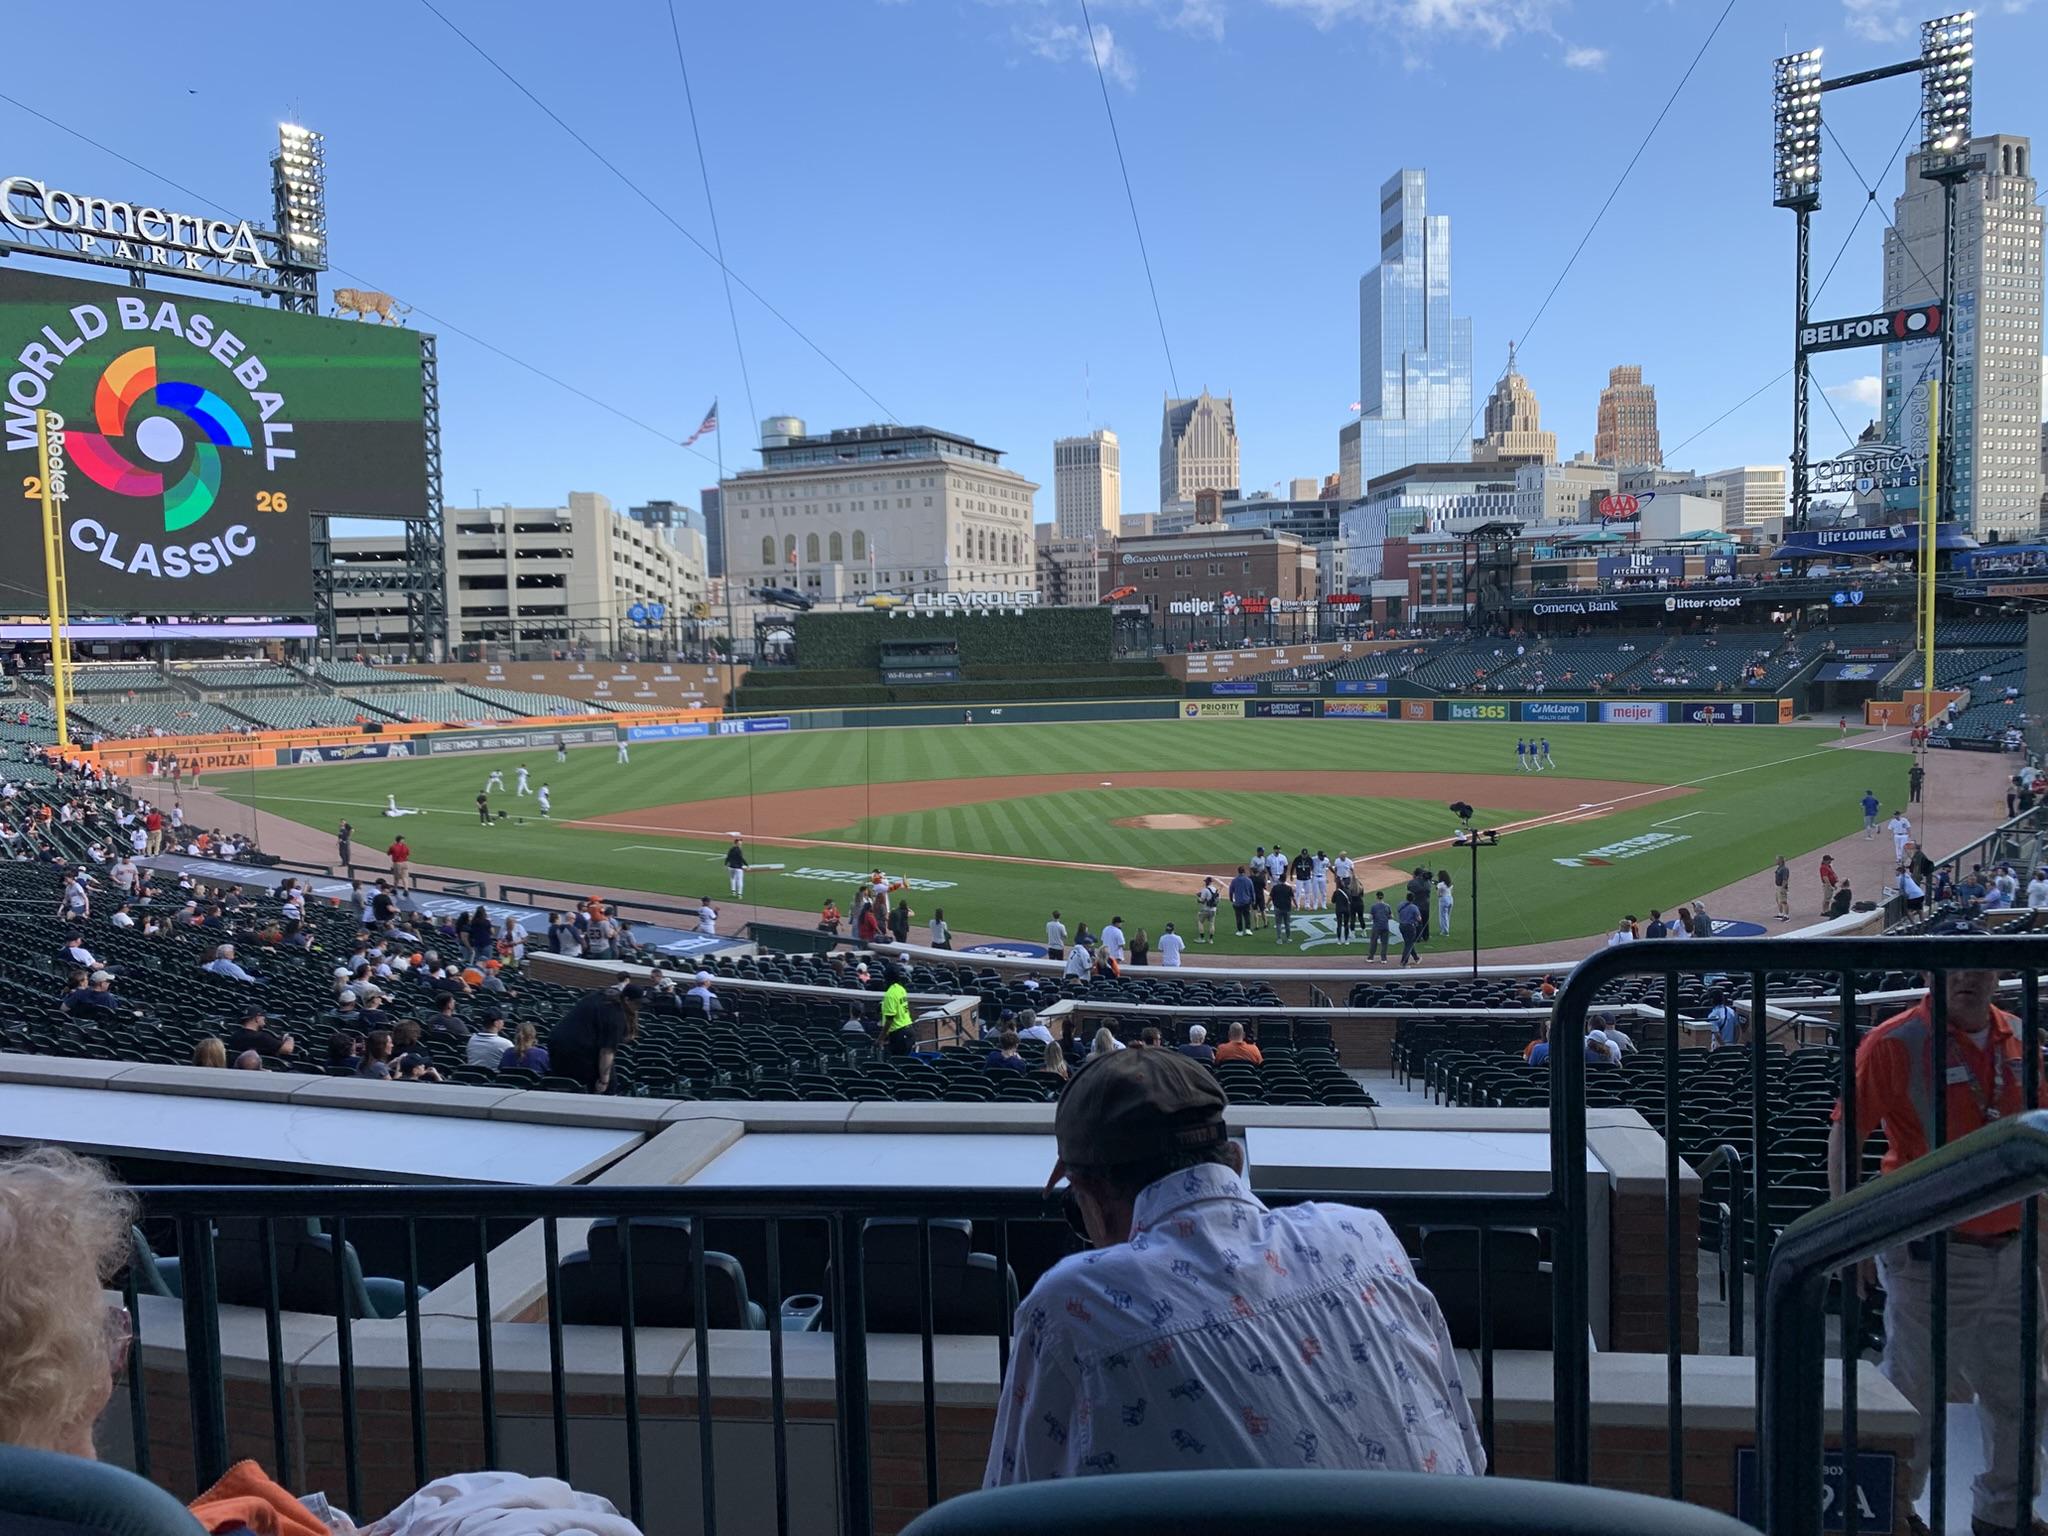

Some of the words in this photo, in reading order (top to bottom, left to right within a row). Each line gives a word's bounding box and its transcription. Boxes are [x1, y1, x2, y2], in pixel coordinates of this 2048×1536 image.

[82, 232, 203, 271] PARK
[1802, 318, 1890, 345] BELFOR
[5, 302, 108, 452] WORLD
[116, 296, 296, 471] BASEBALL
[47, 431, 70, 501] Rocket
[1815, 475, 1918, 494] LANDING
[255, 492, 289, 514] 26
[1818, 531, 1842, 546] Lite
[1842, 529, 1887, 541] LOUNGE
[70, 518, 256, 579] CLASSIC
[1132, 555, 1159, 564] GRAND
[1157, 553, 1183, 562] VALLEY
[1183, 552, 1204, 560] STATE
[1205, 551, 1249, 559] UNIVERSITY
[1630, 553, 1653, 568] Lite
[913, 591, 1042, 606] CHEVROLET
[1588, 600, 1618, 612] Bank
[888, 609, 1024, 619] FOUNTAIN
[1170, 597, 1215, 616] meijer
[1244, 605, 1266, 613] TIRE
[1340, 602, 1360, 612] LAW
[1275, 649, 1284, 658] 10
[1342, 643, 1352, 652] 42
[1452, 704, 1505, 718] bet365
[1541, 704, 1580, 714] McLaren
[1613, 705, 1653, 720] meijer
[1693, 710, 1726, 721] Coona
[721, 721, 745, 733] DTE
[207, 753, 251, 768] PIZZA!
